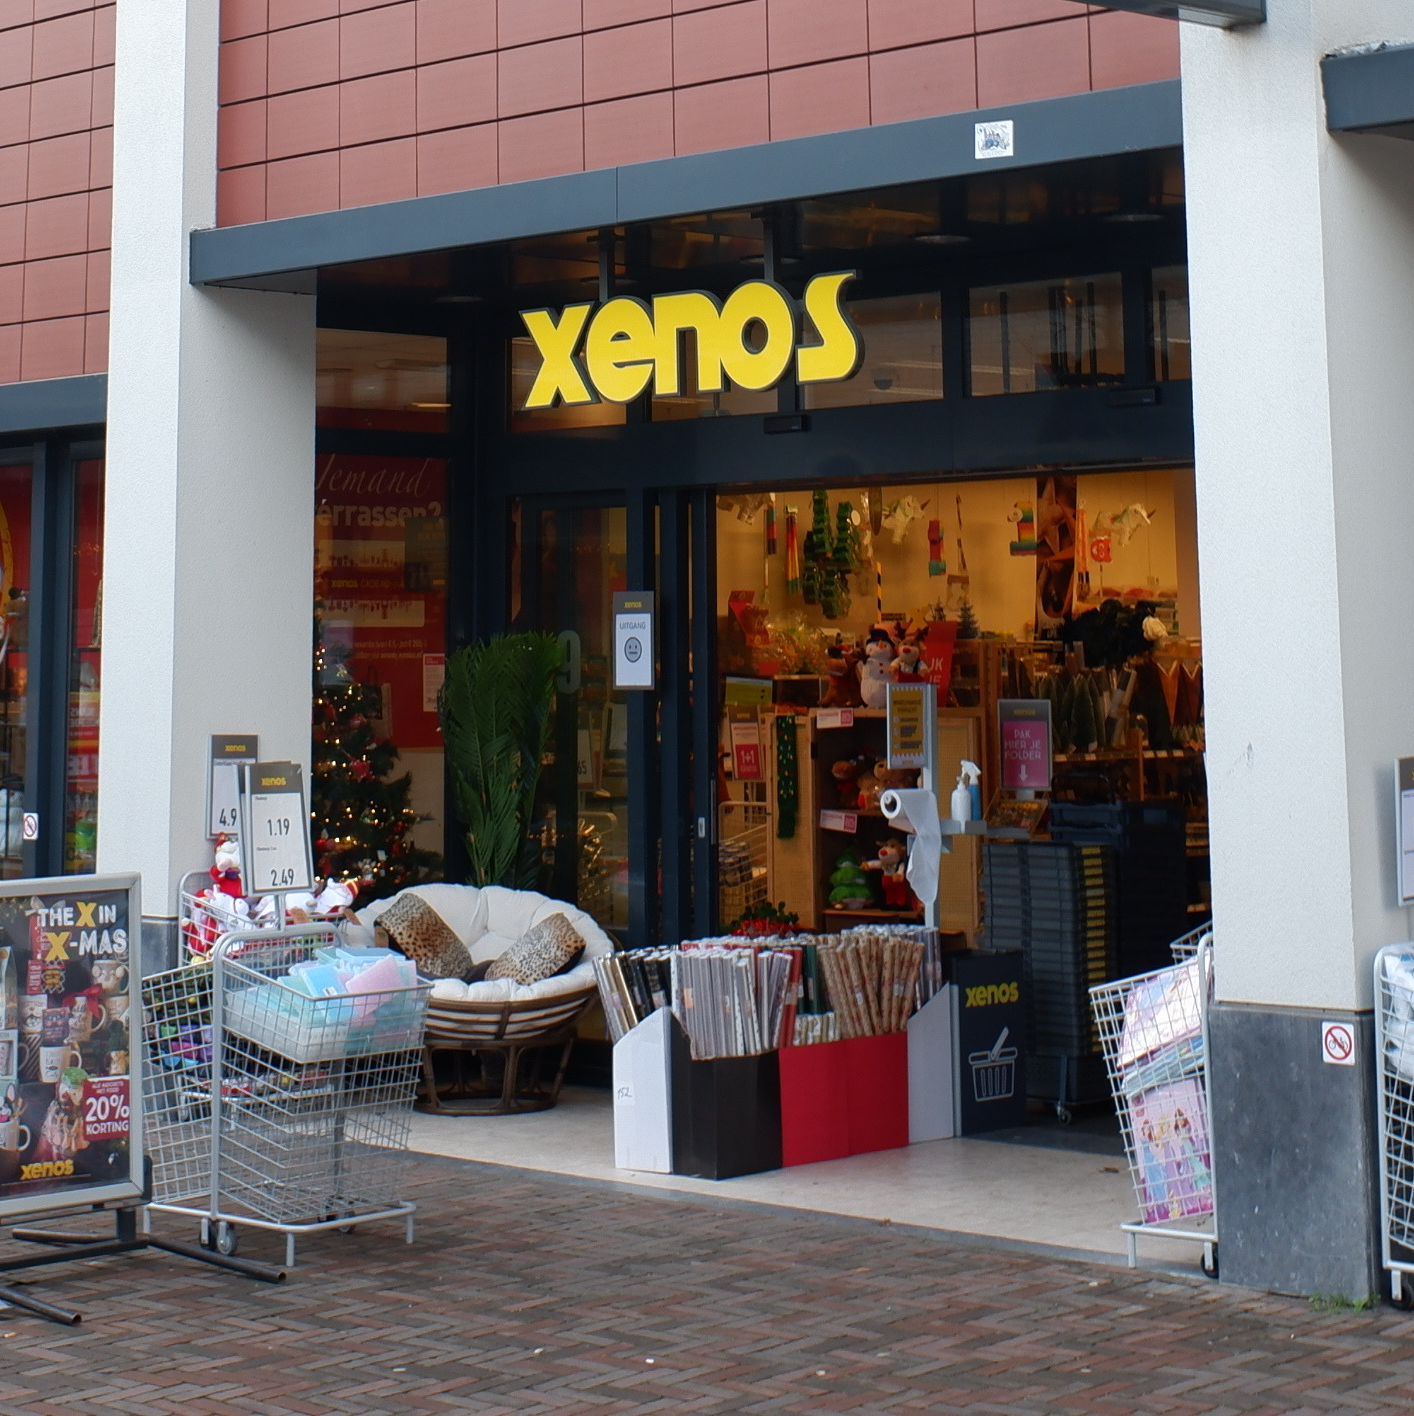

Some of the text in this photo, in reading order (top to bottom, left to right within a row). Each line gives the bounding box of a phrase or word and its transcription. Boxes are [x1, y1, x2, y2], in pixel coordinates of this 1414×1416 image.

[518, 269, 862, 410] xenos
[619, 622, 646, 630] UITGANG
[1014, 729, 1031, 739] PAK
[1004, 740, 1041, 749] HIER JE
[740, 749, 756, 764] 1+1
[1004, 750, 1042, 759] FOLDER
[261, 777, 287, 786] xenos
[219, 808, 237, 827] 4.9
[267, 818, 290, 836] 1.19
[270, 868, 295, 887] 2.49
[38, 902, 117, 928] THE X IN
[44, 928, 127, 961] X-MAS
[965, 981, 1020, 1008] xenos
[85, 1094, 130, 1122] 20%
[86, 1120, 129, 1135] KORTING
[19, 1159, 75, 1181] xenos
